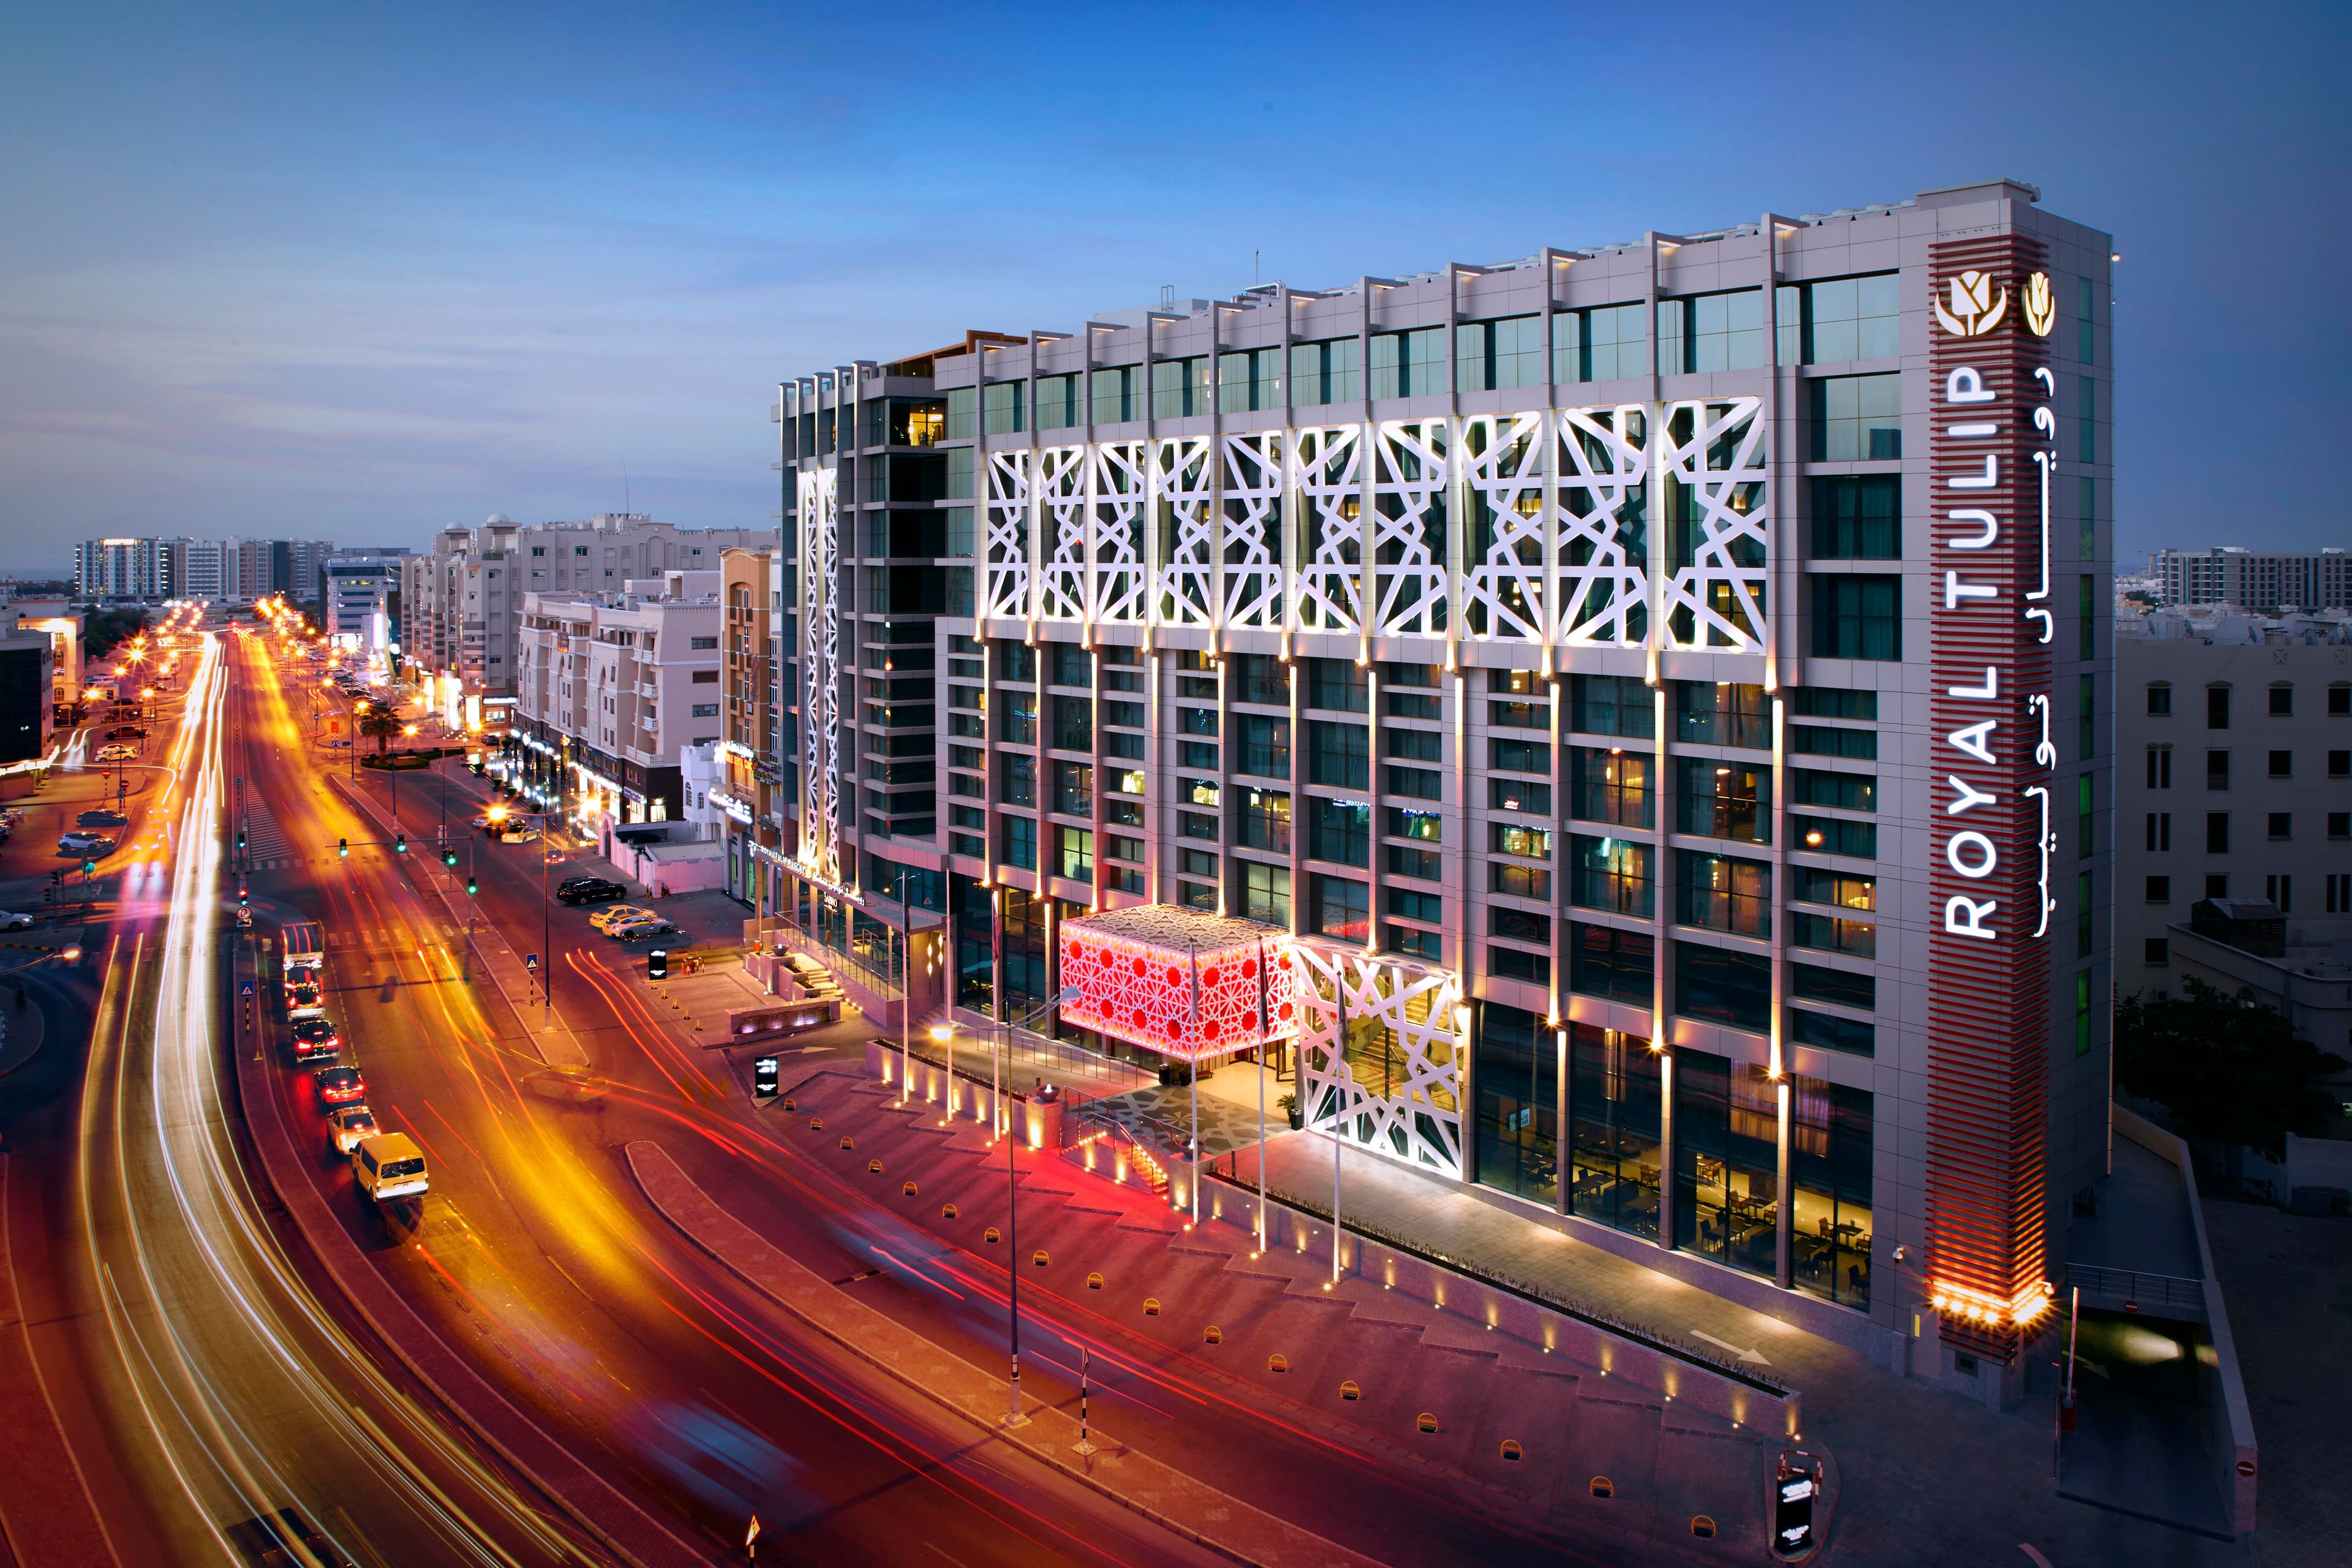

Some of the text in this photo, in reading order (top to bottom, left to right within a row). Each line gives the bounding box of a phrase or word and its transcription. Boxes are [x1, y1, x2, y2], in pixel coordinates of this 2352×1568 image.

[761, 845, 805, 873] ROYAL TULIP MUSCAT
[1945, 366, 1997, 939] ROYAL TULIP
[2026, 367, 2056, 938] رويال توليب
